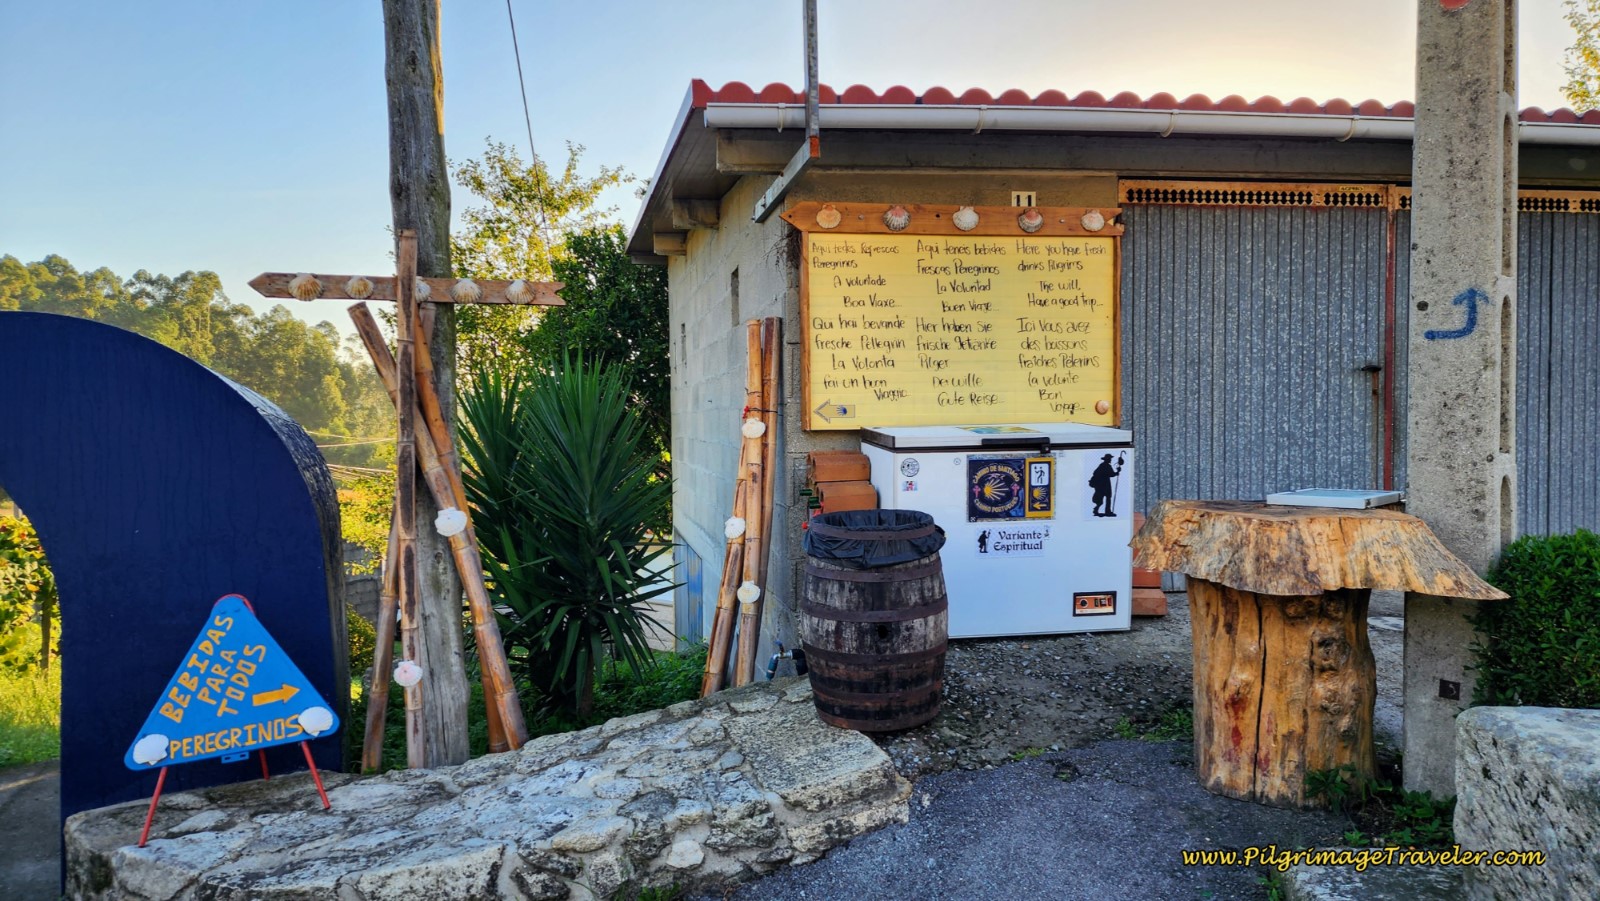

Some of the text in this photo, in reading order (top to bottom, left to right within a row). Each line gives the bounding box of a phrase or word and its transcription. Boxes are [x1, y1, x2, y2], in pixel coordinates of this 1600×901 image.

[974, 243, 1006, 256] bebidas
[1016, 238, 1040, 255] Here
[1062, 241, 1081, 256] have
[1084, 242, 1106, 256] fresh
[953, 258, 1000, 276] Peregrinos
[936, 278, 947, 294] La
[1040, 281, 1054, 293] The
[843, 295, 866, 308] Boa
[1028, 293, 1050, 307] Have
[1059, 296, 1079, 310] good
[813, 314, 905, 330] Qui hai bevande
[916, 316, 938, 333] Hier
[977, 320, 993, 333] Sie
[1016, 317, 1036, 333] Ici
[1066, 322, 1091, 334] avez
[815, 334, 852, 350] fresche
[916, 335, 951, 351] frische
[1020, 335, 1088, 351] des boissons
[832, 353, 845, 370] La
[918, 352, 949, 371] Pilger
[937, 391, 965, 407] Gute
[1039, 389, 1062, 400] Bon
[998, 465, 1020, 482] SANTIAGO
[998, 531, 1042, 540] Variante
[994, 540, 1043, 553] Espiritual
[159, 615, 234, 724] BEBIDAS
[197, 649, 237, 705] PARA
[216, 644, 266, 717] TODOS
[169, 714, 304, 760] PEREGRINOS
